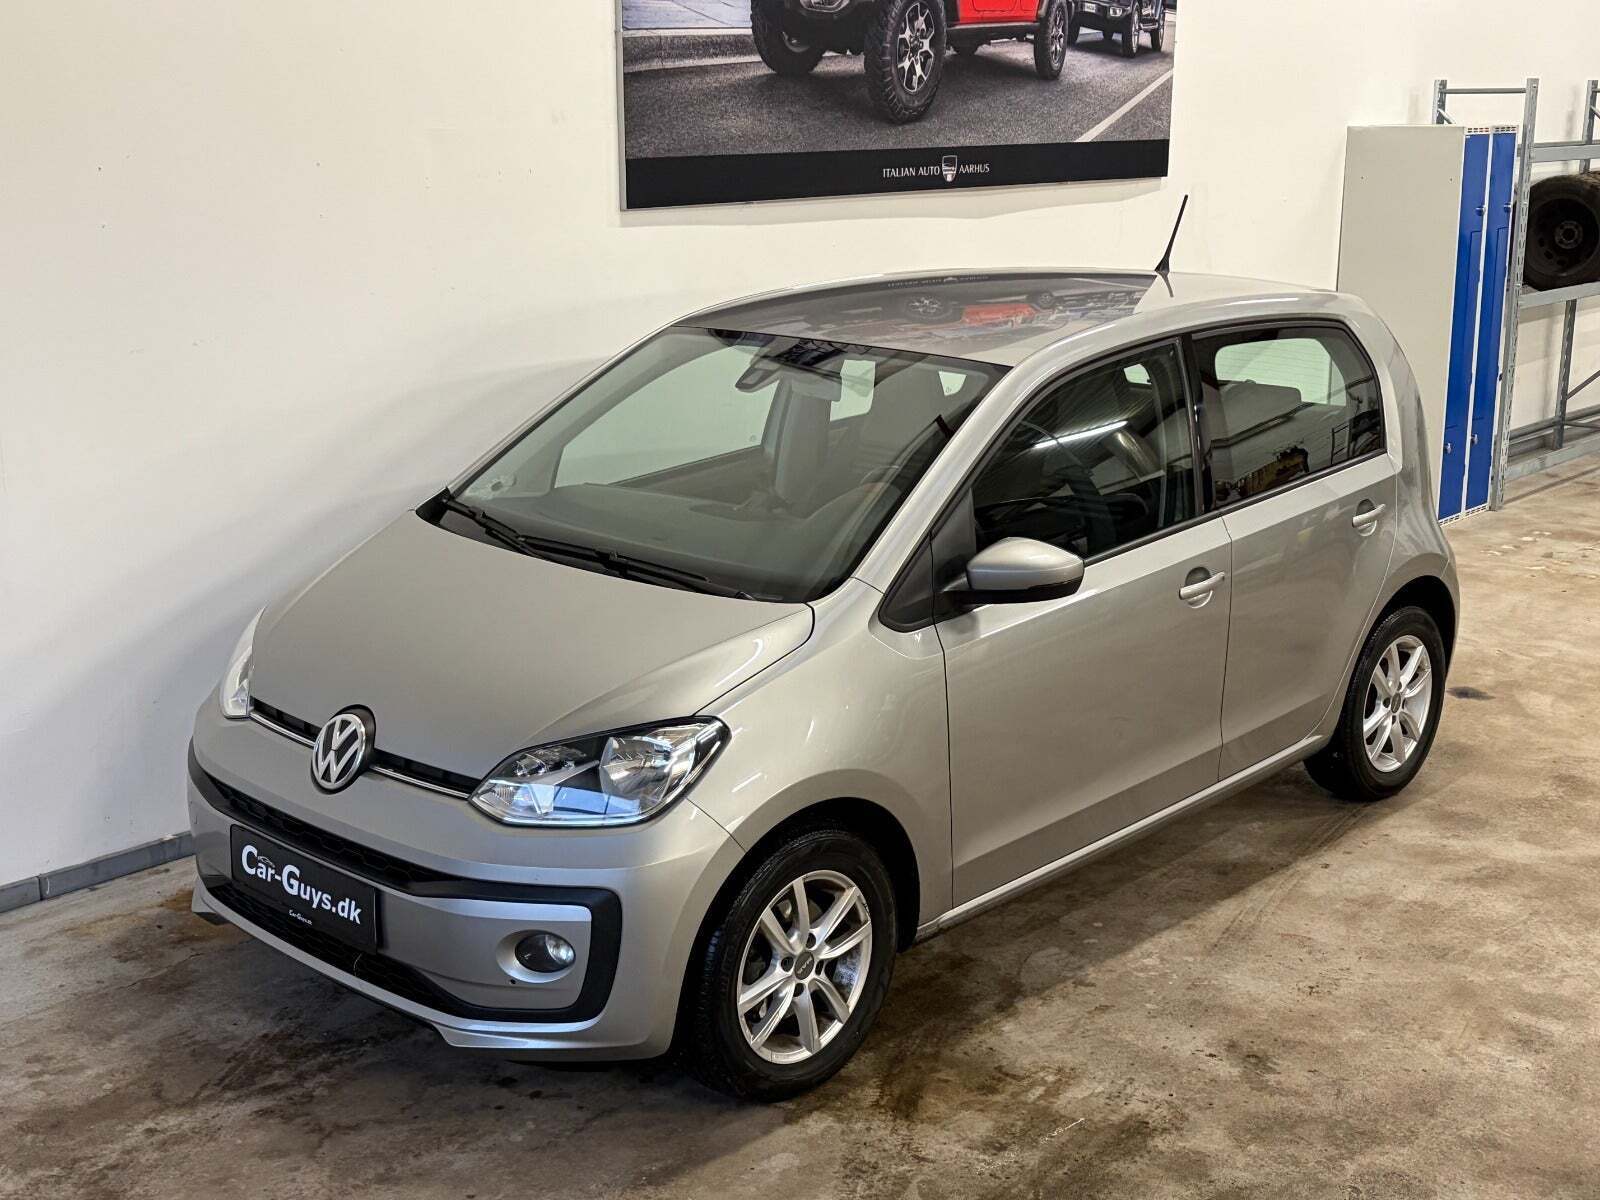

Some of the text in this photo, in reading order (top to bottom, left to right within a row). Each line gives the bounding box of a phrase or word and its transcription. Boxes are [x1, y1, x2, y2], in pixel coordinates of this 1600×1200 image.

[882, 163, 990, 178] ITALIAN AUTO AARHUS
[241, 844, 362, 925] Car-Guys.dk
